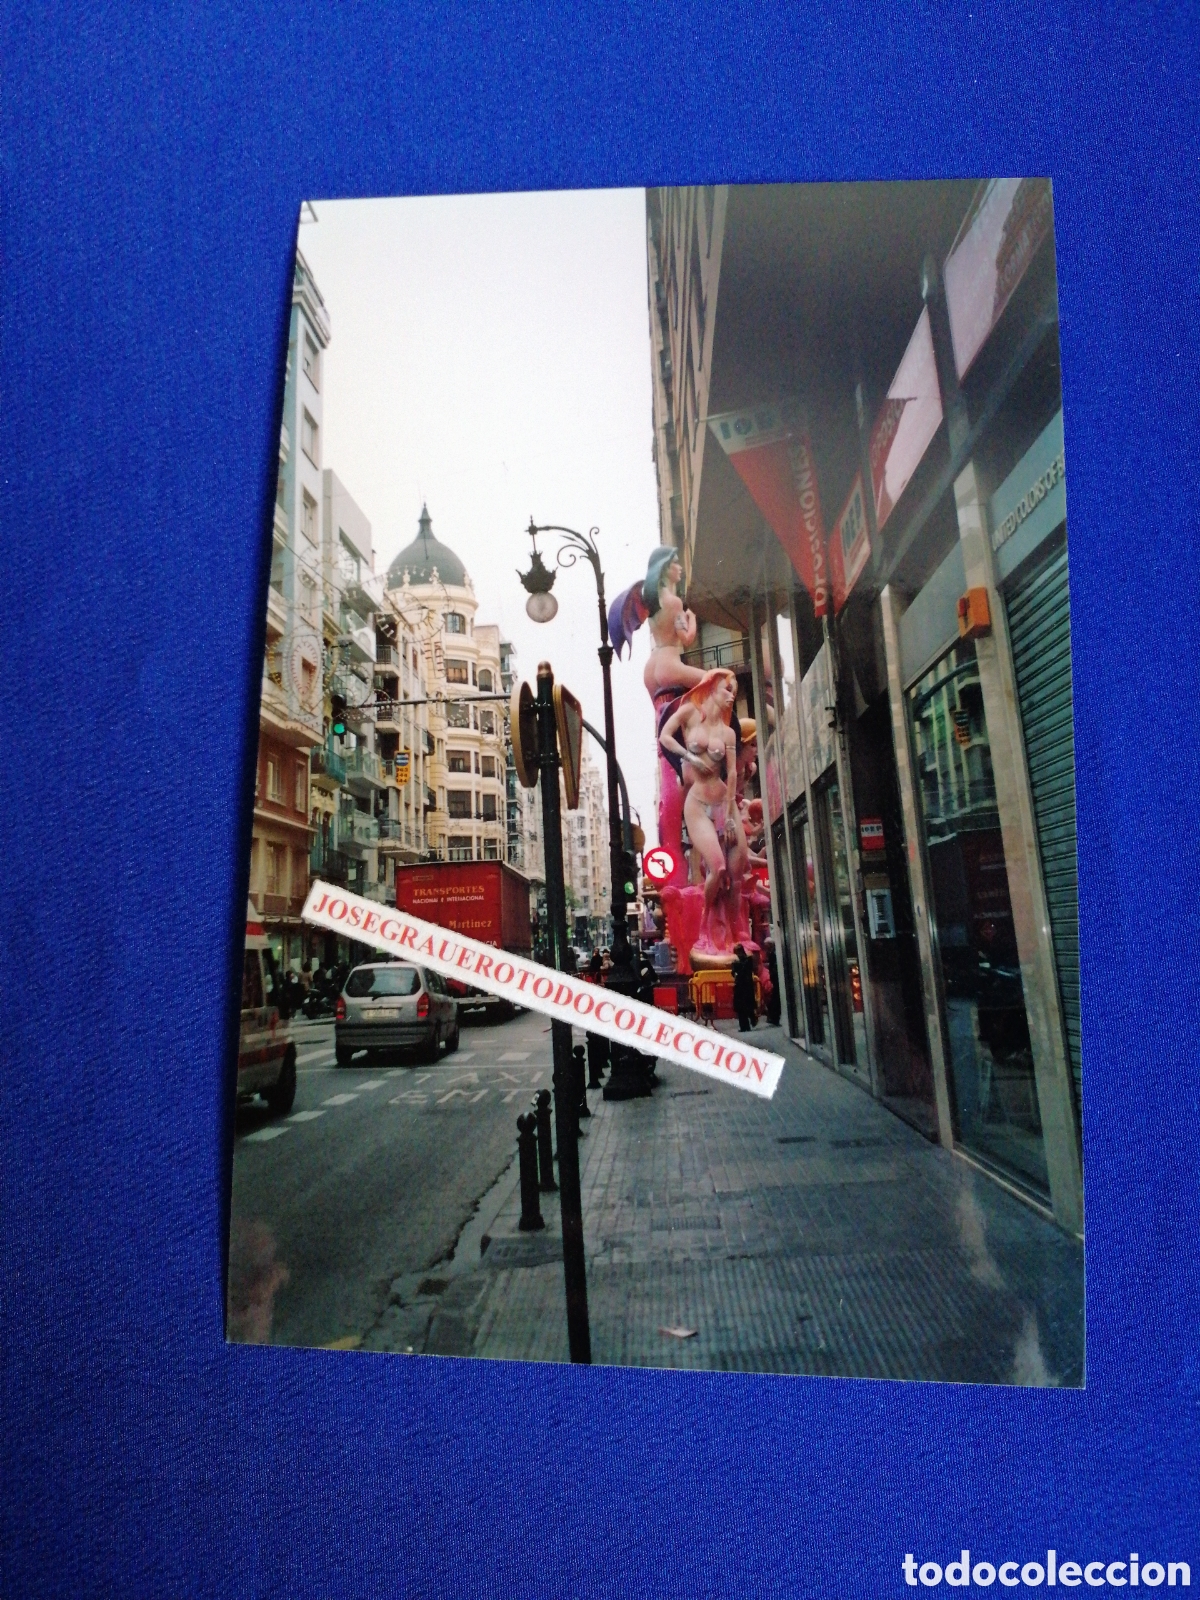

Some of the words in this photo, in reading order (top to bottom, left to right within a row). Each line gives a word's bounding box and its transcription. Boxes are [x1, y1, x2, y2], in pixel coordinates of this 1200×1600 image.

[413, 884, 485, 898] TRANSPORTES
[313, 893, 769, 1083] JOSEGRAUEROTODOCOLECCION
[414, 1071, 544, 1084] TAXI
